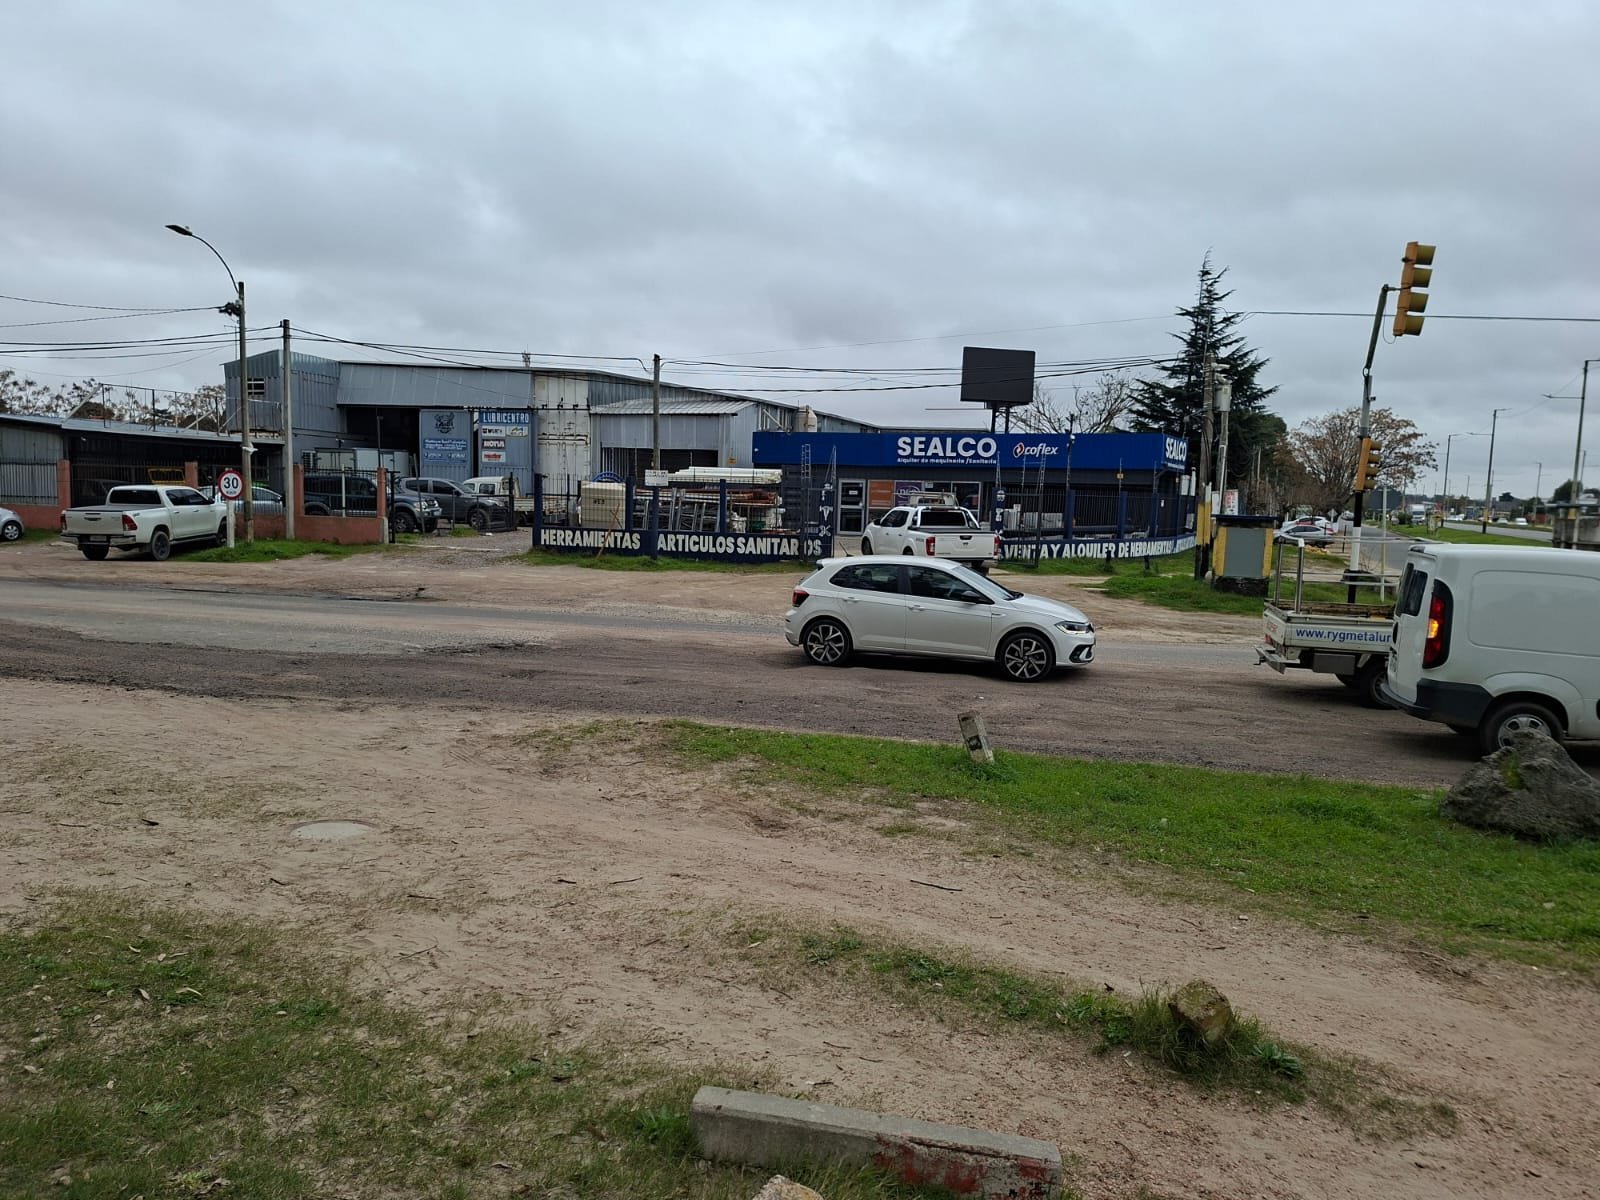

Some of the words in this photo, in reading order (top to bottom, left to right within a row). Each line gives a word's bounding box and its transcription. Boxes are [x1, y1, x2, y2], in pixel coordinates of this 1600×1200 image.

[897, 436, 997, 458] SEALCO
[1024, 442, 1058, 457] coflex
[1166, 437, 1187, 462] SEALCO
[224, 477, 238, 488] 30
[540, 528, 641, 550] HERRAMIENTAS
[657, 534, 735, 554] ARTICULOS
[736, 536, 822, 556] SANITAROS
[1050, 543, 1061, 559] Y
[1118, 542, 1129, 558] DE
